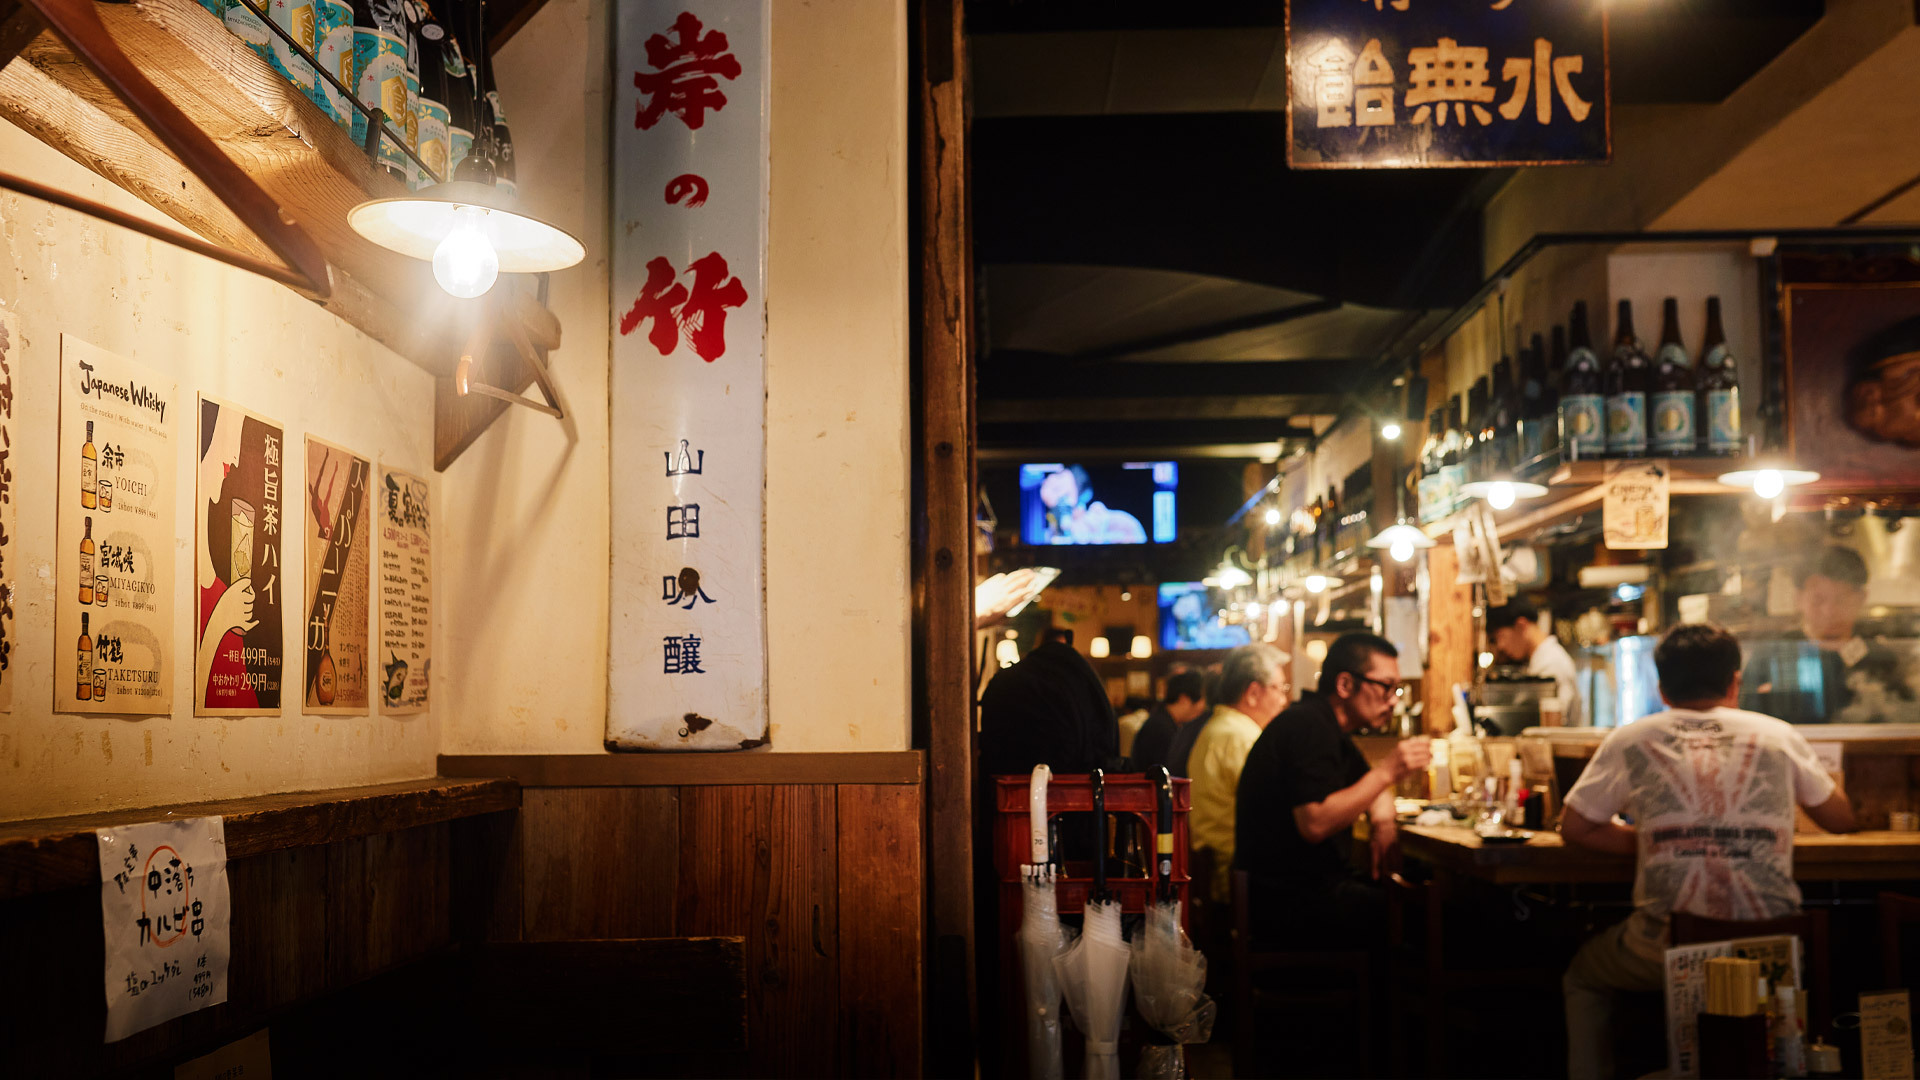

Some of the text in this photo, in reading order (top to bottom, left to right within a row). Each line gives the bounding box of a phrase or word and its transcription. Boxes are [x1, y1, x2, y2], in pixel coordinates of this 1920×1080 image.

[619, 11, 748, 363] 岸の竹
[79, 360, 166, 424] Japanese Whisky
[98, 409, 113, 419] rocks
[102, 442, 124, 471] 余市
[115, 476, 147, 496] YOICHI
[262, 433, 279, 605] 極旨茶ハイ
[109, 577, 155, 594] MIYAGIKYO
[96, 634, 123, 665] 竹鶴
[107, 668, 159, 684] TAKETSURU
[147, 857, 194, 900] 中落ち
[136, 897, 204, 948] カルビ串
